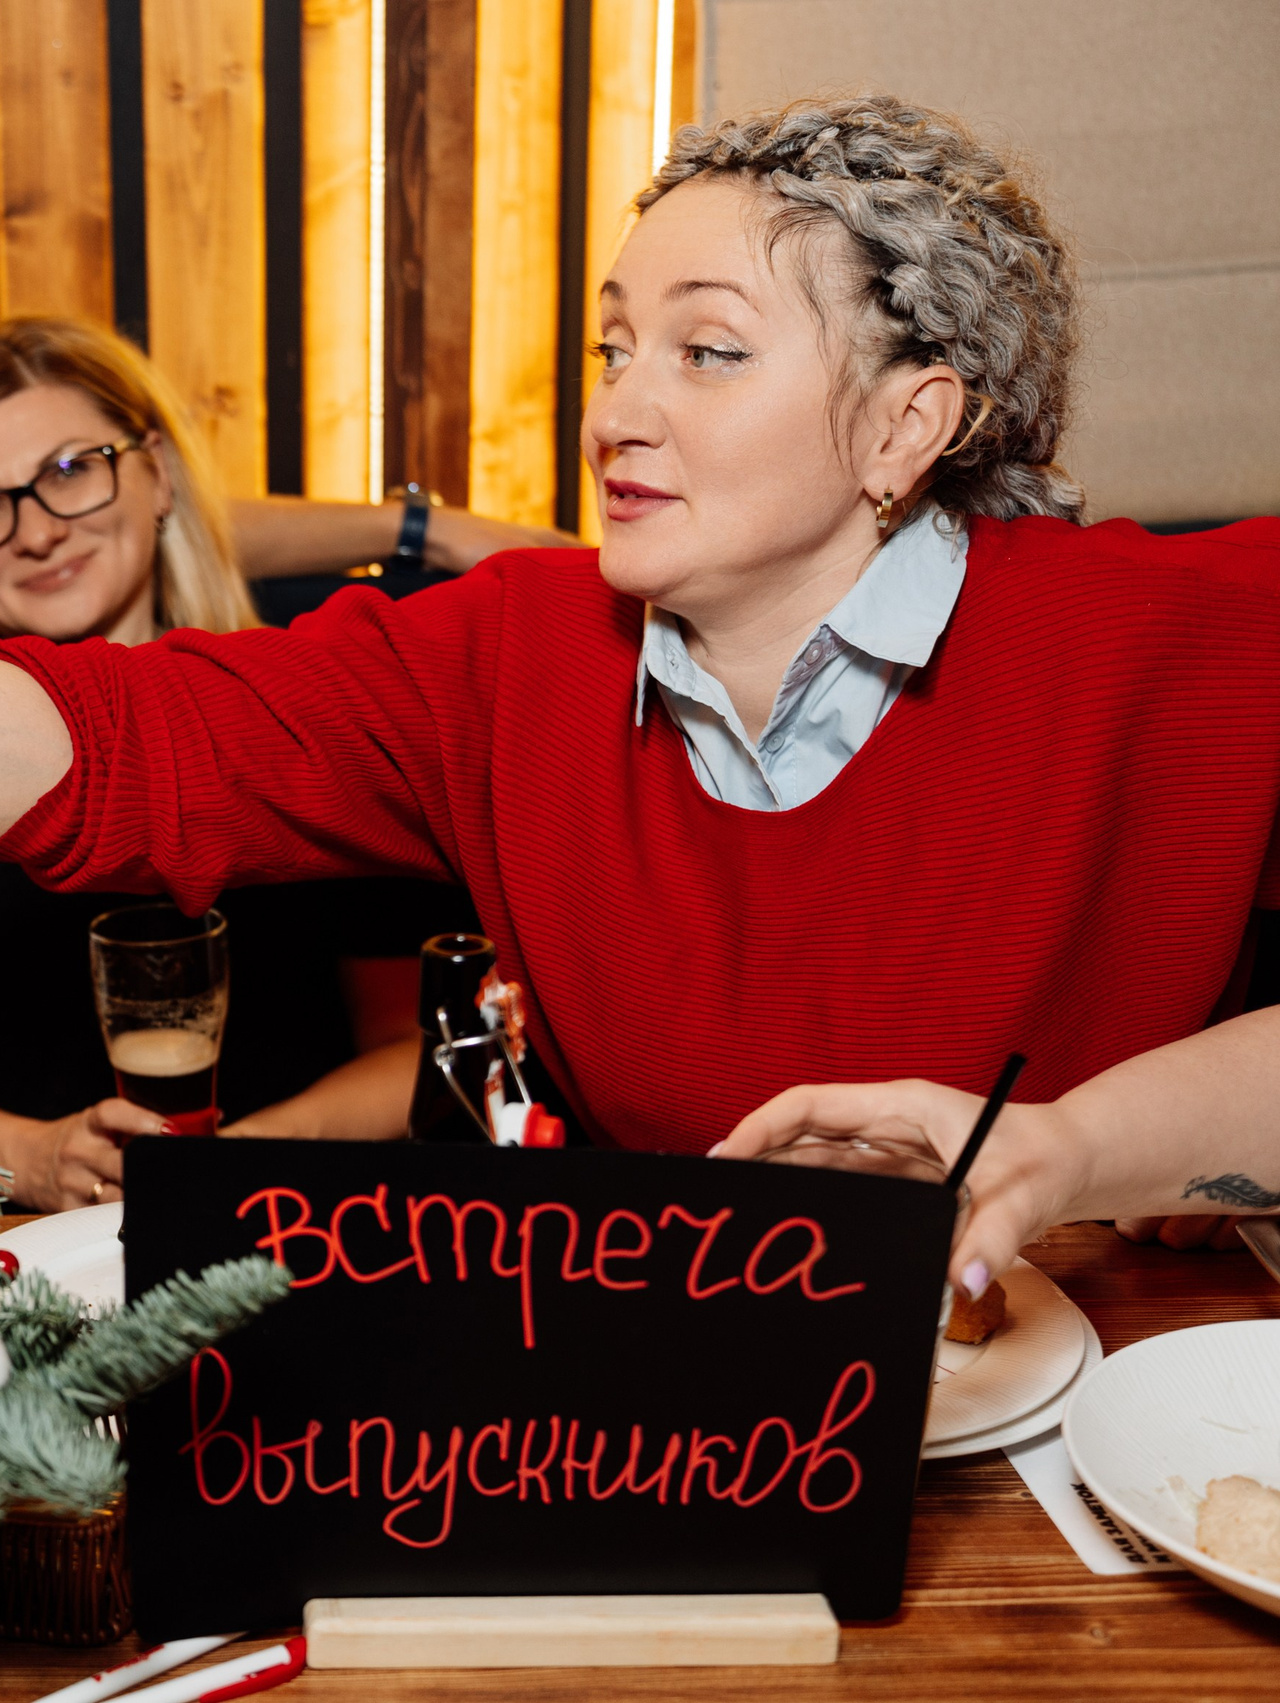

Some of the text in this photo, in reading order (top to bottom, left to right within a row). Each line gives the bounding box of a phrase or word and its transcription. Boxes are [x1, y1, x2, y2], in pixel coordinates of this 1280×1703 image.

[178, 1347, 876, 1548] выпускников
[1070, 1482, 1124, 1536] ЗАМЕТОК
[1112, 1538, 1148, 1564] ДЛЯ
